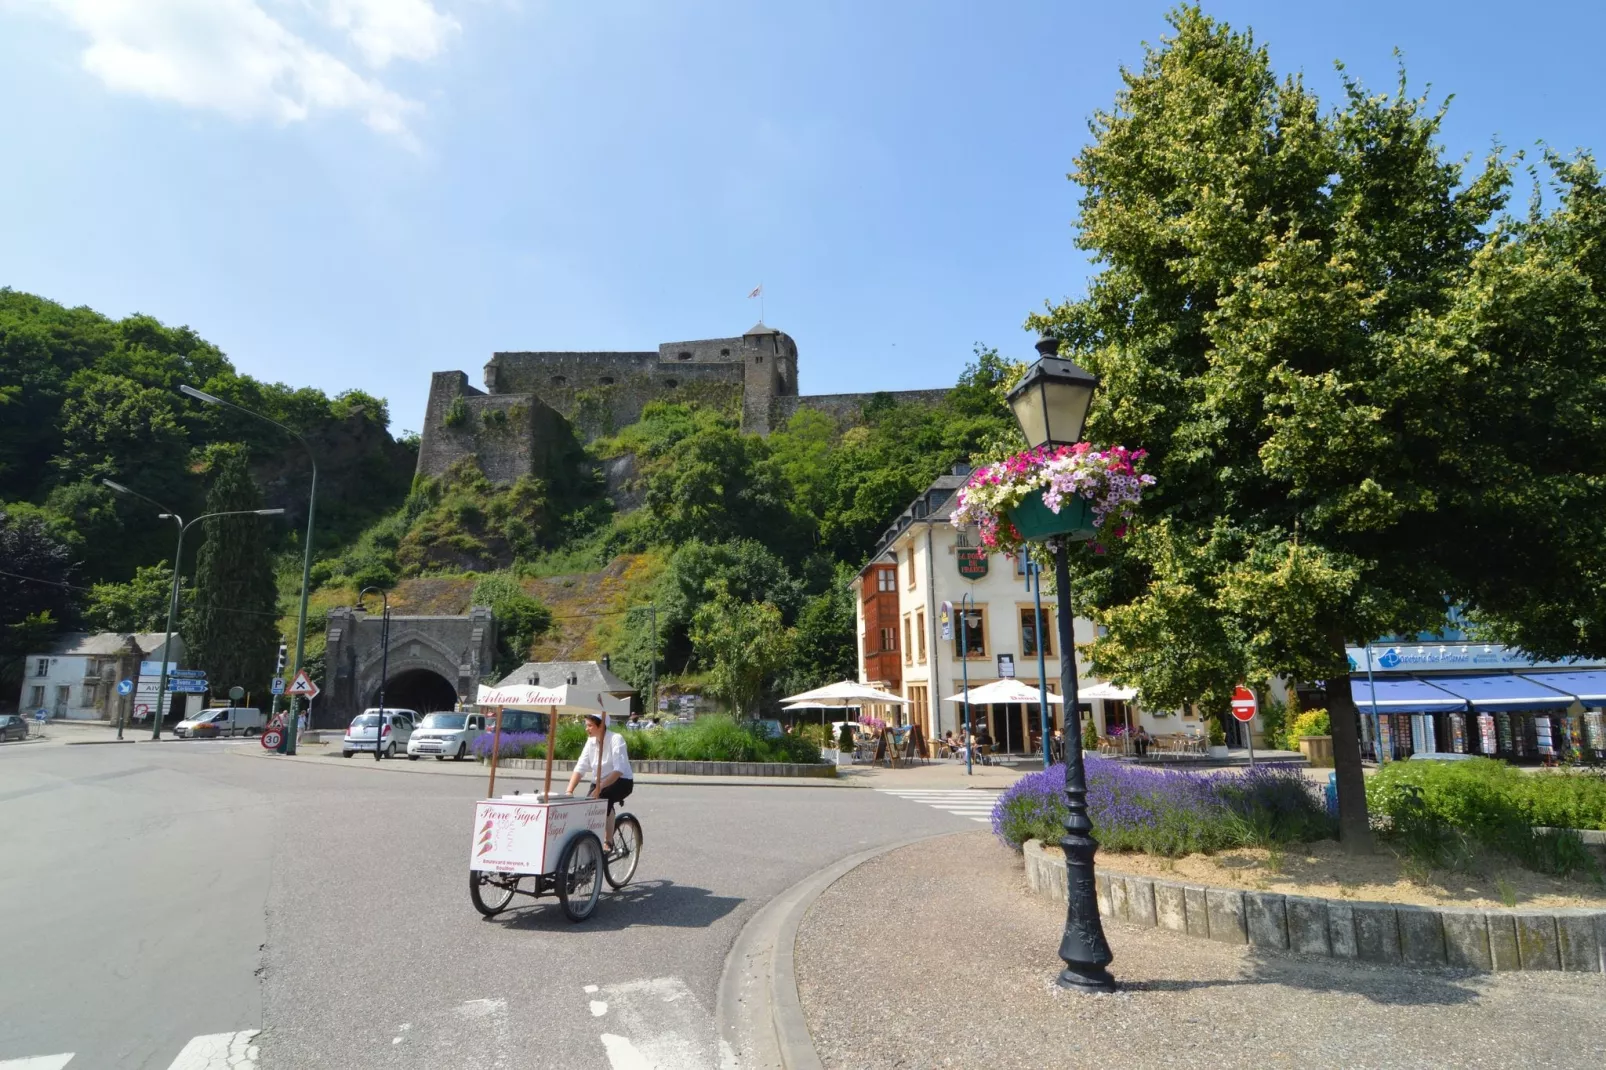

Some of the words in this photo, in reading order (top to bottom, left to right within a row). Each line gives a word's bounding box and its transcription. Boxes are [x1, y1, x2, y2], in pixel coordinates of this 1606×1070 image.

[275, 680, 282, 688] P
[478, 691, 520, 703] Artisan
[526, 691, 563, 703] Glacier
[265, 735, 280, 743] 30
[480, 807, 510, 819] Pierre
